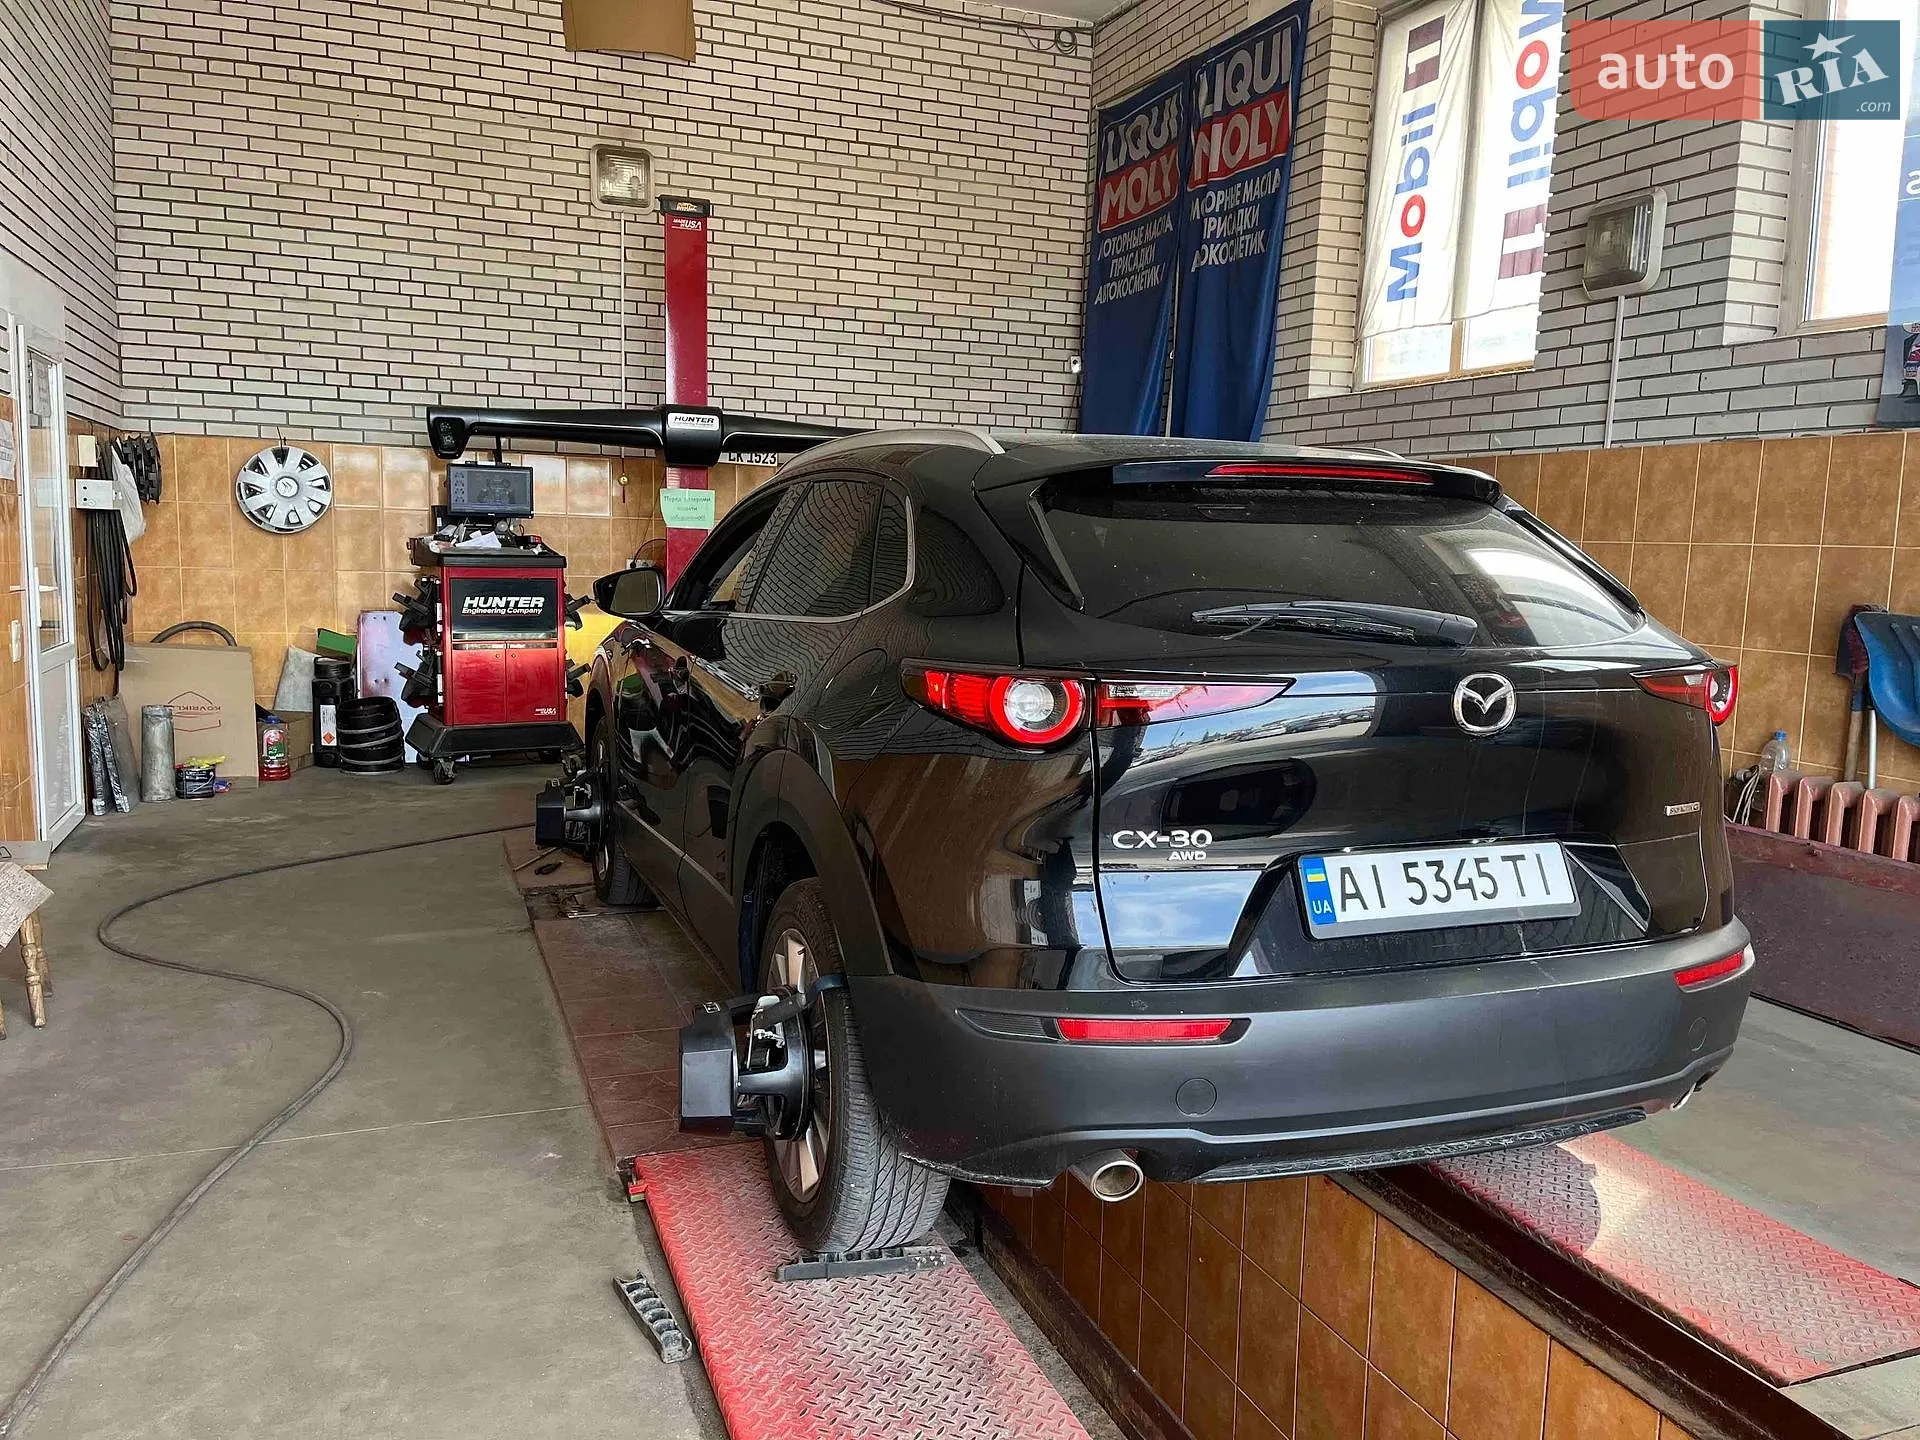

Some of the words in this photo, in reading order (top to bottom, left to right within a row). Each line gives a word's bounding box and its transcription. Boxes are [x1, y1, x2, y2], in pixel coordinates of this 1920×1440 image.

[1198, 26, 1292, 120] LIQUI
[1106, 93, 1178, 173] LIQUI
[1101, 148, 1176, 225] MOLY
[1387, 102, 1436, 302] Mobil
[685, 219, 702, 229] USA
[674, 415, 715, 424] HUNTER
[747, 452, 777, 465] 1523
[463, 596, 545, 608] HUNTER
[461, 607, 506, 616] Engineering
[507, 607, 543, 616] Company
[1112, 829, 1213, 849] CX-30
[1168, 850, 1207, 861] AWD
[1340, 864, 1386, 912] AI
[1402, 856, 1499, 906] 5345
[1501, 853, 1551, 897] TI
[1312, 898, 1333, 915] UA
